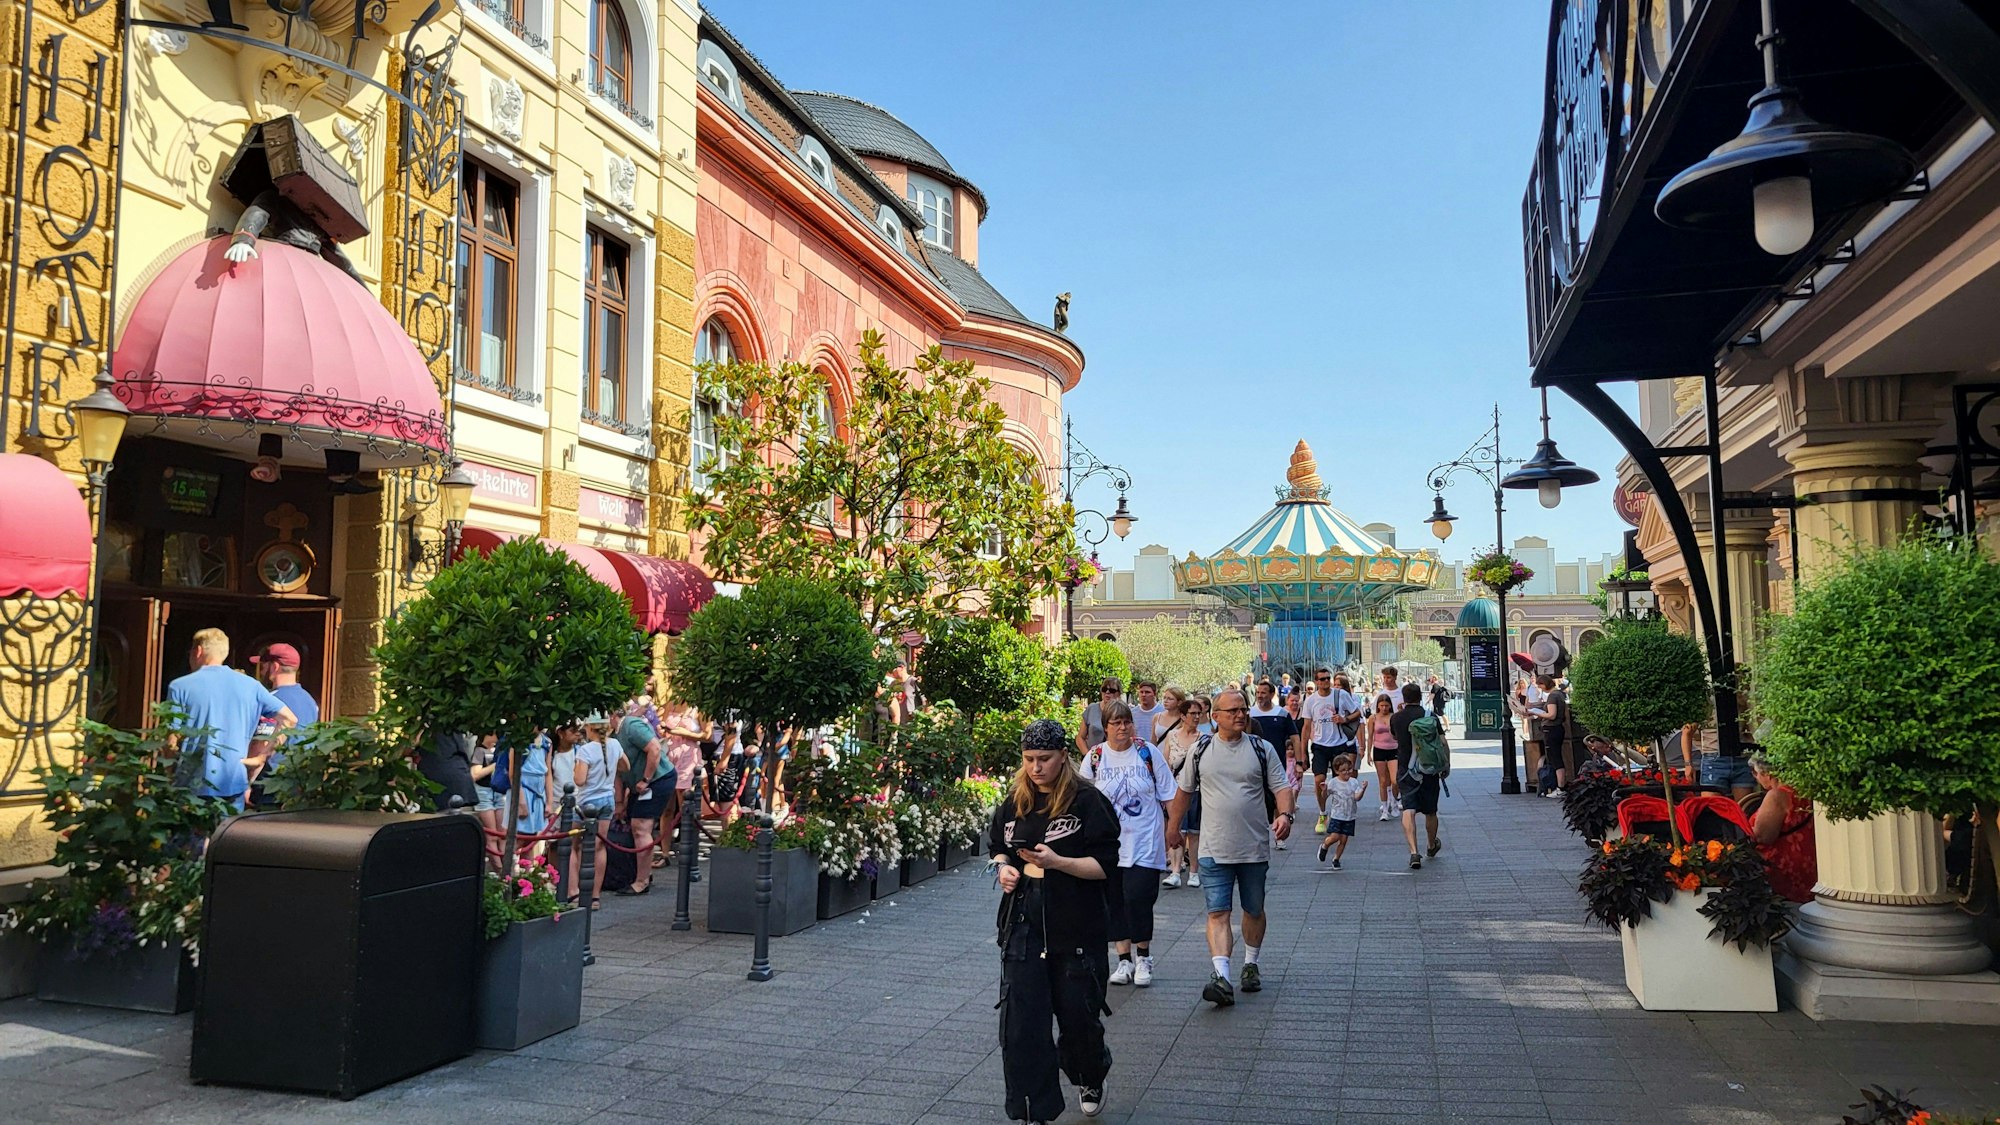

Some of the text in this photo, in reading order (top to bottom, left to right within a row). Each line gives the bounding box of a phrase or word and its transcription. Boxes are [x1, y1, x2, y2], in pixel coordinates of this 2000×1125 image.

[172, 480, 187, 496] 15
[462, 468, 529, 498] er-kehrte
[598, 494, 624, 517] Welt
